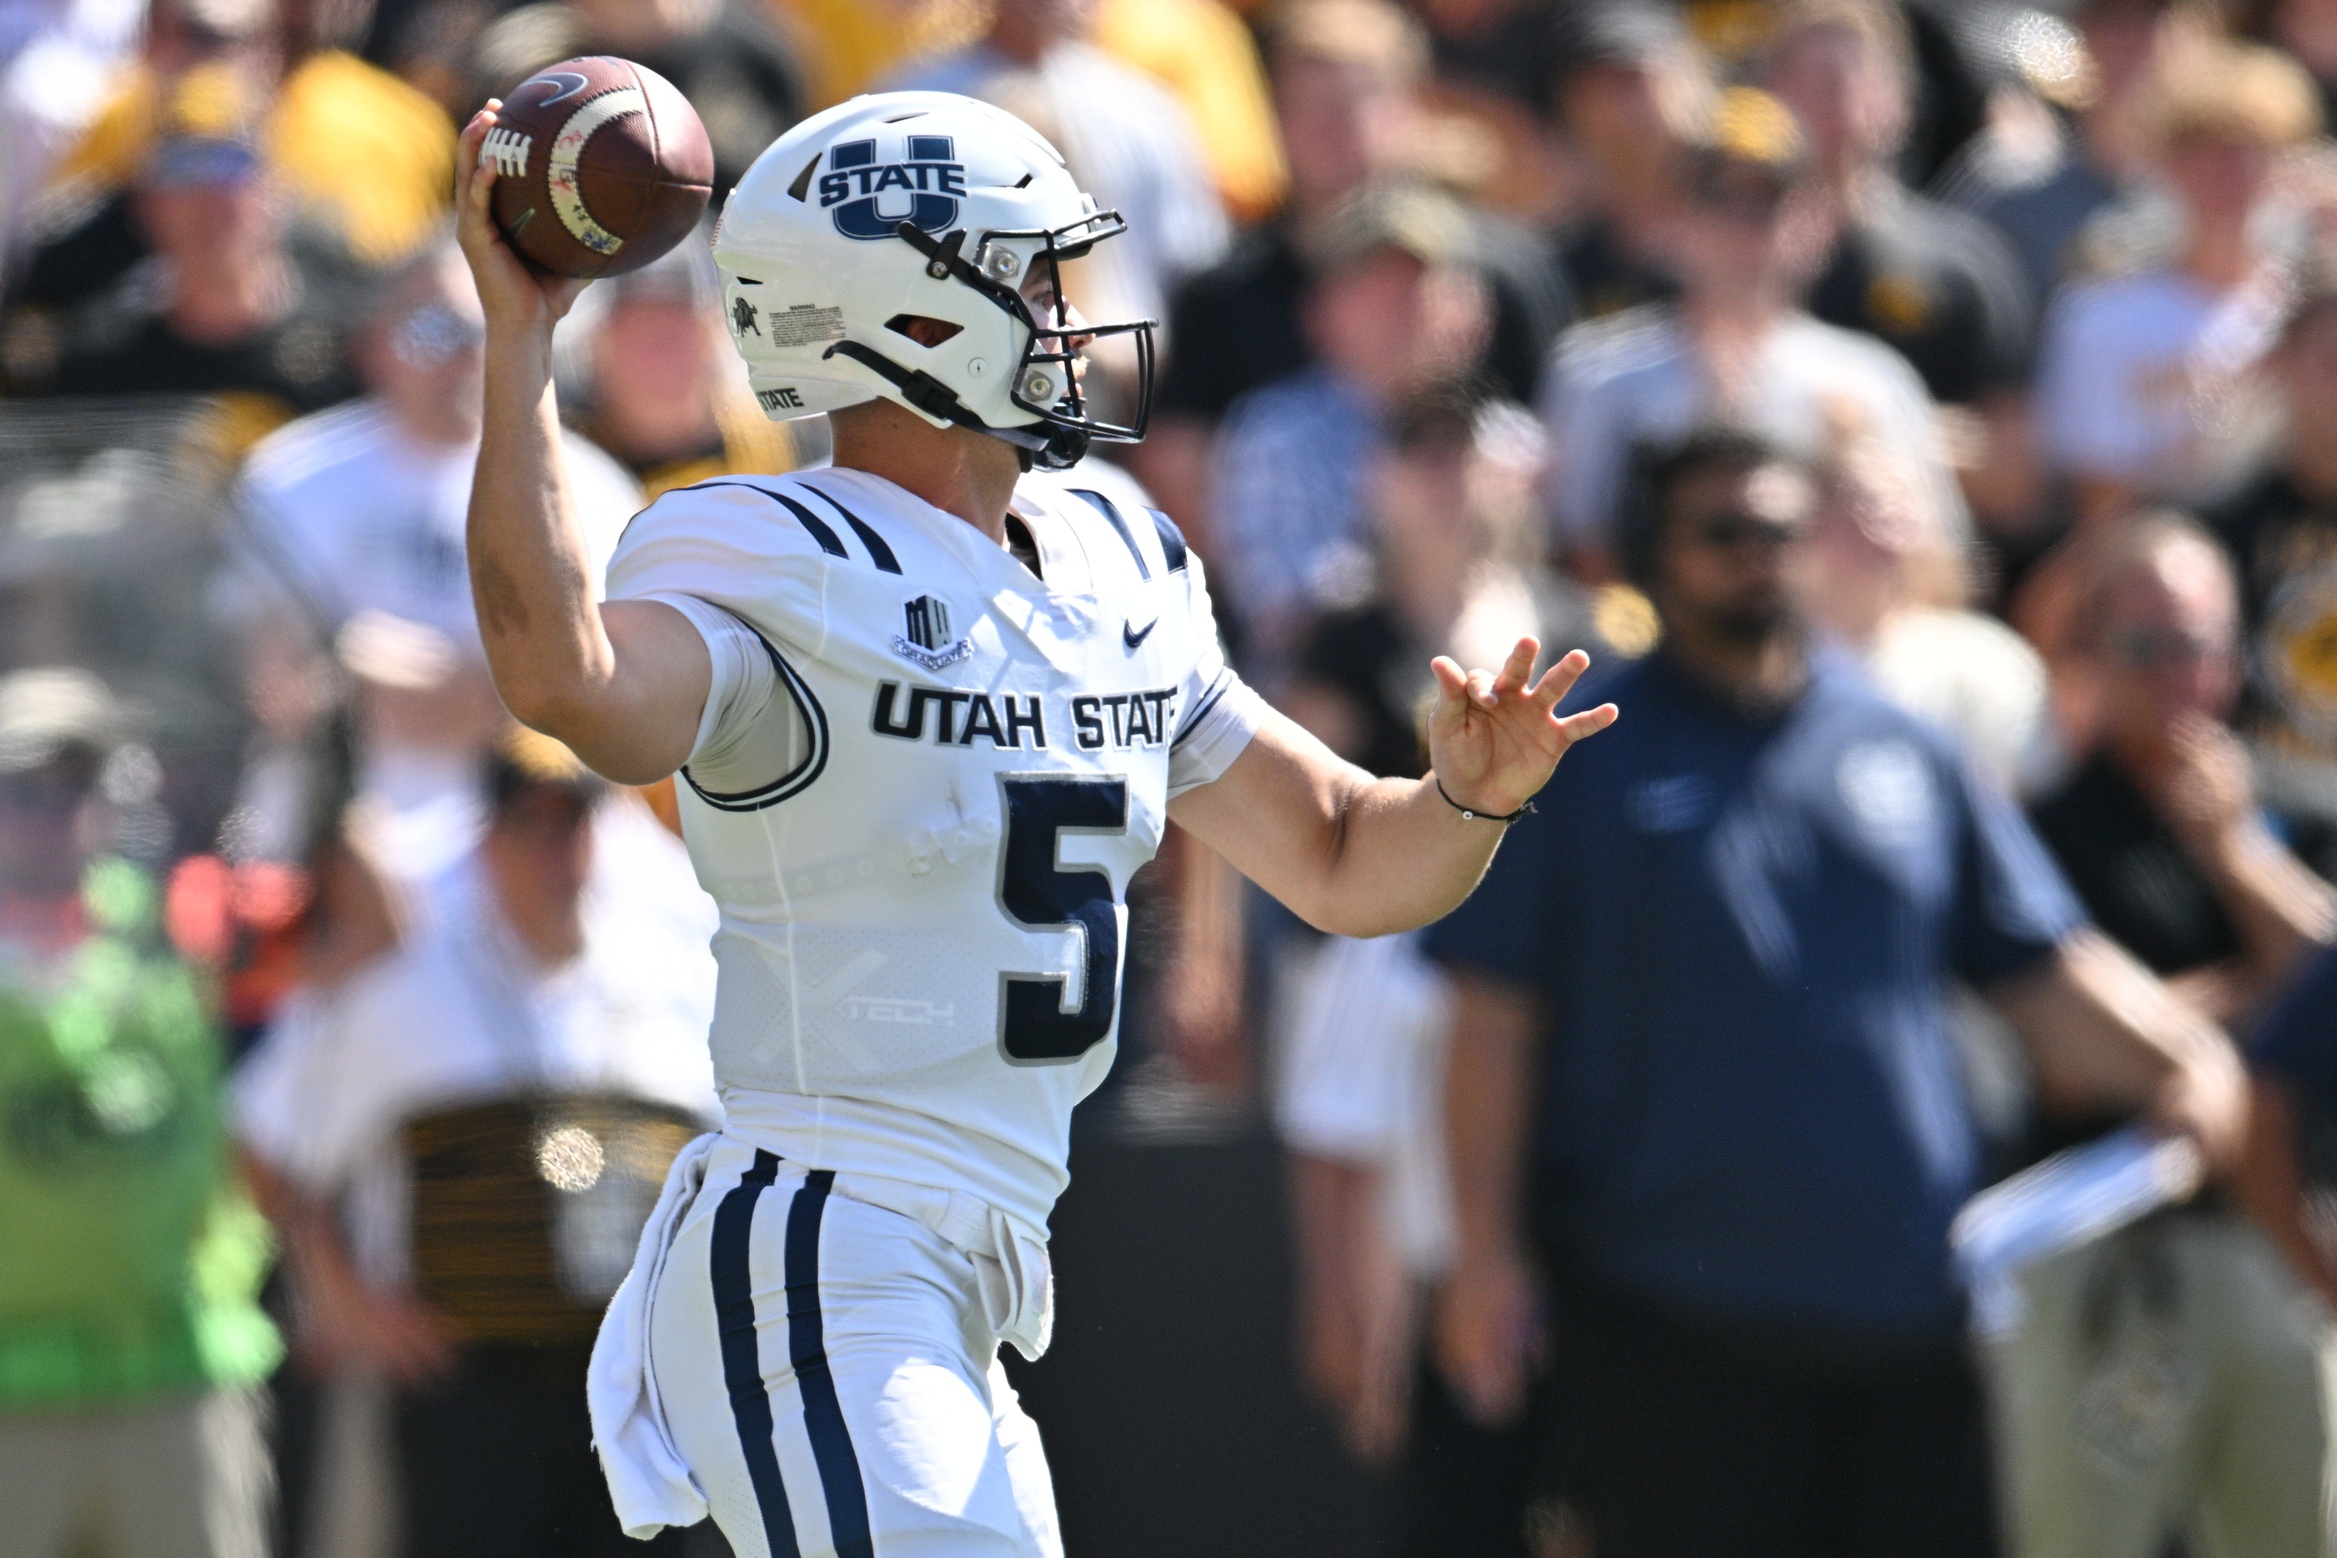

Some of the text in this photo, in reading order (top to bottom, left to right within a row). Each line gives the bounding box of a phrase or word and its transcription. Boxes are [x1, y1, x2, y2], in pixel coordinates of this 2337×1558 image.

[819, 162, 968, 208] STATE
[830, 134, 958, 240] U
[756, 387, 804, 412] TATE
[901, 645, 966, 669] GRADUATE
[872, 681, 1048, 750] UTAH
[996, 772, 1129, 1067] 5
[846, 994, 955, 1026] TECH
